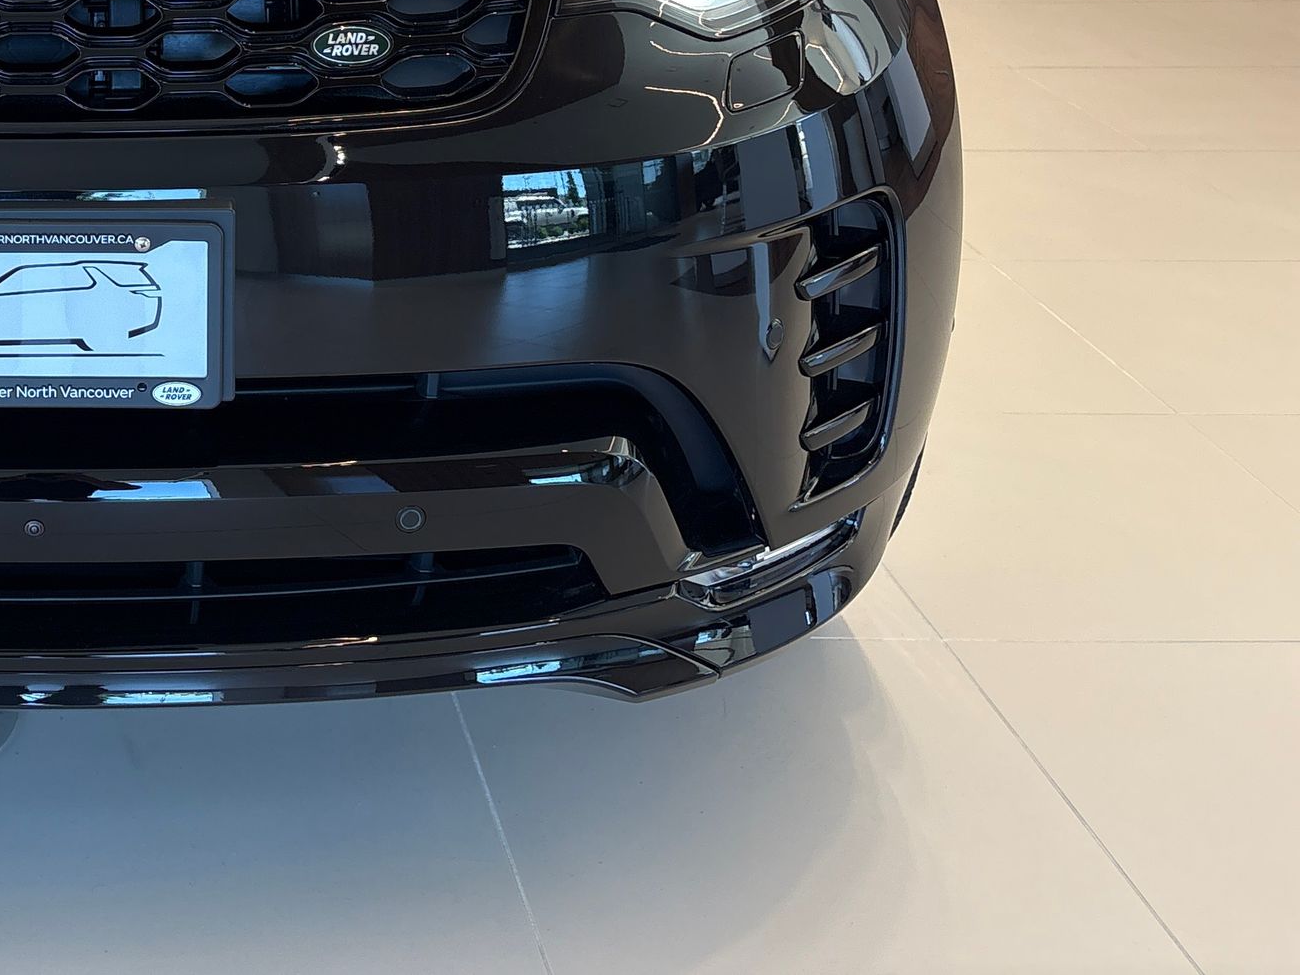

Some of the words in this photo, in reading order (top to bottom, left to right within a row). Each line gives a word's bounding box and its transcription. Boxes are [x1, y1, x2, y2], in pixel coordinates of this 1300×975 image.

[327, 32, 366, 45] LAND
[331, 43, 379, 57] ROVER
[16, 385, 57, 398] North
[59, 385, 135, 399] Vancouver
[162, 386, 186, 394] LAND
[164, 393, 192, 401] ROVER
